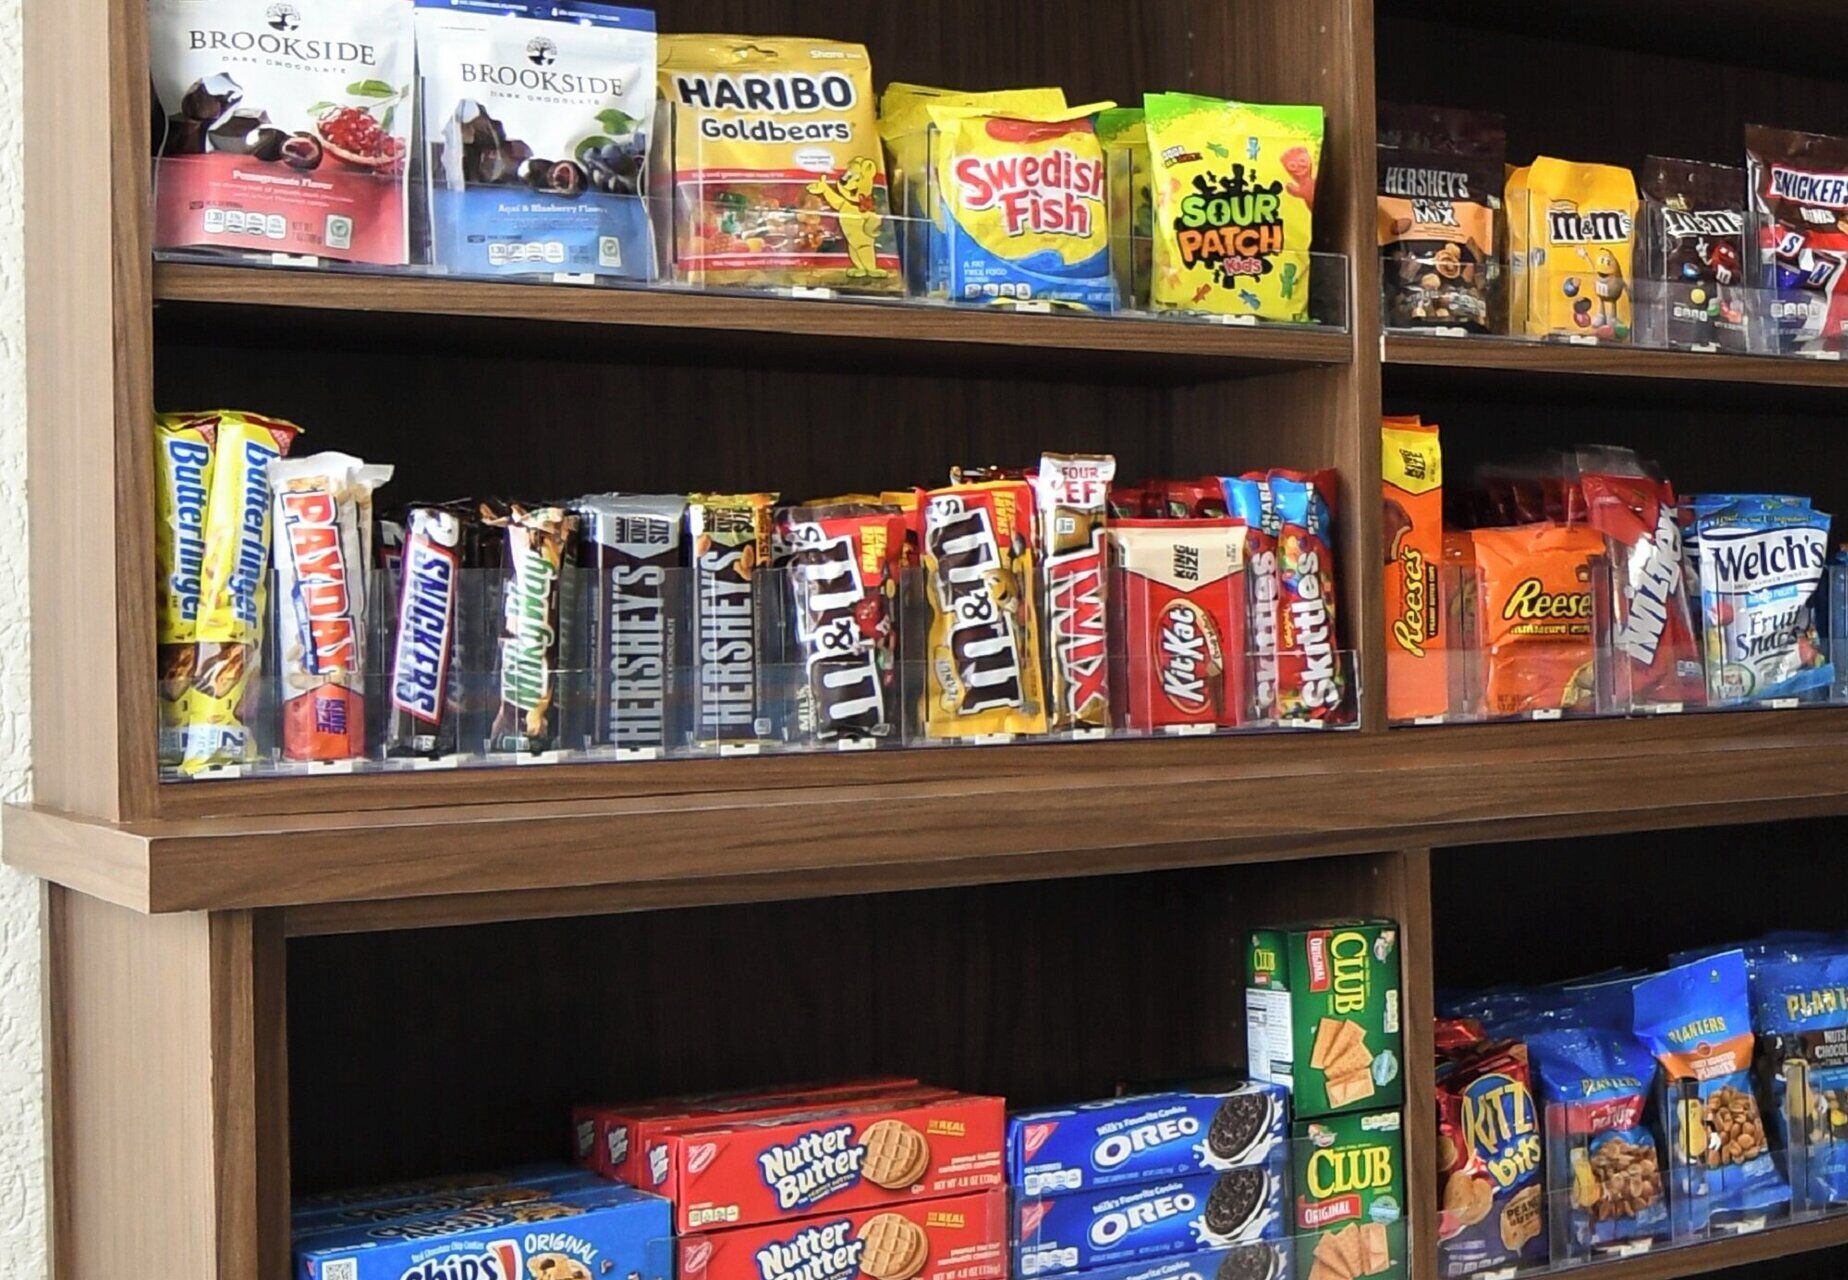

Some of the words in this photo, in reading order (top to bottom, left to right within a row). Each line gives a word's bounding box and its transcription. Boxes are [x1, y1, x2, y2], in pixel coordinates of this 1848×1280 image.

[189, 29, 376, 67] BROOKSIDE
[462, 62, 622, 97] BROOKSIDE
[677, 75, 852, 111] HARIBO
[701, 117, 850, 142] Goldbears
[957, 150, 1106, 205] Swedish
[1385, 167, 1469, 198] HERSHEY'S
[1000, 189, 1089, 234] Fish
[1181, 194, 1280, 227] SOUR
[1179, 226, 1283, 263] PATCH
[1224, 258, 1261, 277] Kids
[169, 440, 210, 620] Butterfinger
[229, 441, 279, 630] Butterfinger
[284, 491, 357, 675] PAYDAY
[1173, 543, 1187, 581] KING
[1186, 545, 1200, 582] SIZE
[1714, 538, 1824, 585] Welch's
[1393, 545, 1426, 658] Reese's
[420, 557, 451, 713] SNICKERS
[701, 551, 753, 726] HERSHEY'S
[1292, 550, 1338, 710] Skittles
[610, 566, 666, 746] HERSHEY'S
[1163, 605, 1206, 703] KitKat
[316, 697, 332, 734] SIZE
[332, 698, 348, 735] KING
[1253, 948, 1276, 971] CLUB
[1310, 937, 1323, 983] ORIGINAL
[1330, 932, 1366, 1015] CLUB
[759, 1125, 852, 1184] Nutter
[1093, 1117, 1200, 1168] OREO
[776, 1145, 863, 1210] Butter
[1307, 1148, 1393, 1200] CLUB
[1090, 1193, 1197, 1247] OREO
[1304, 1201, 1352, 1224] ORIGINAL
[525, 1232, 600, 1266] ORIGINAL
[757, 1222, 850, 1280] Nutter
